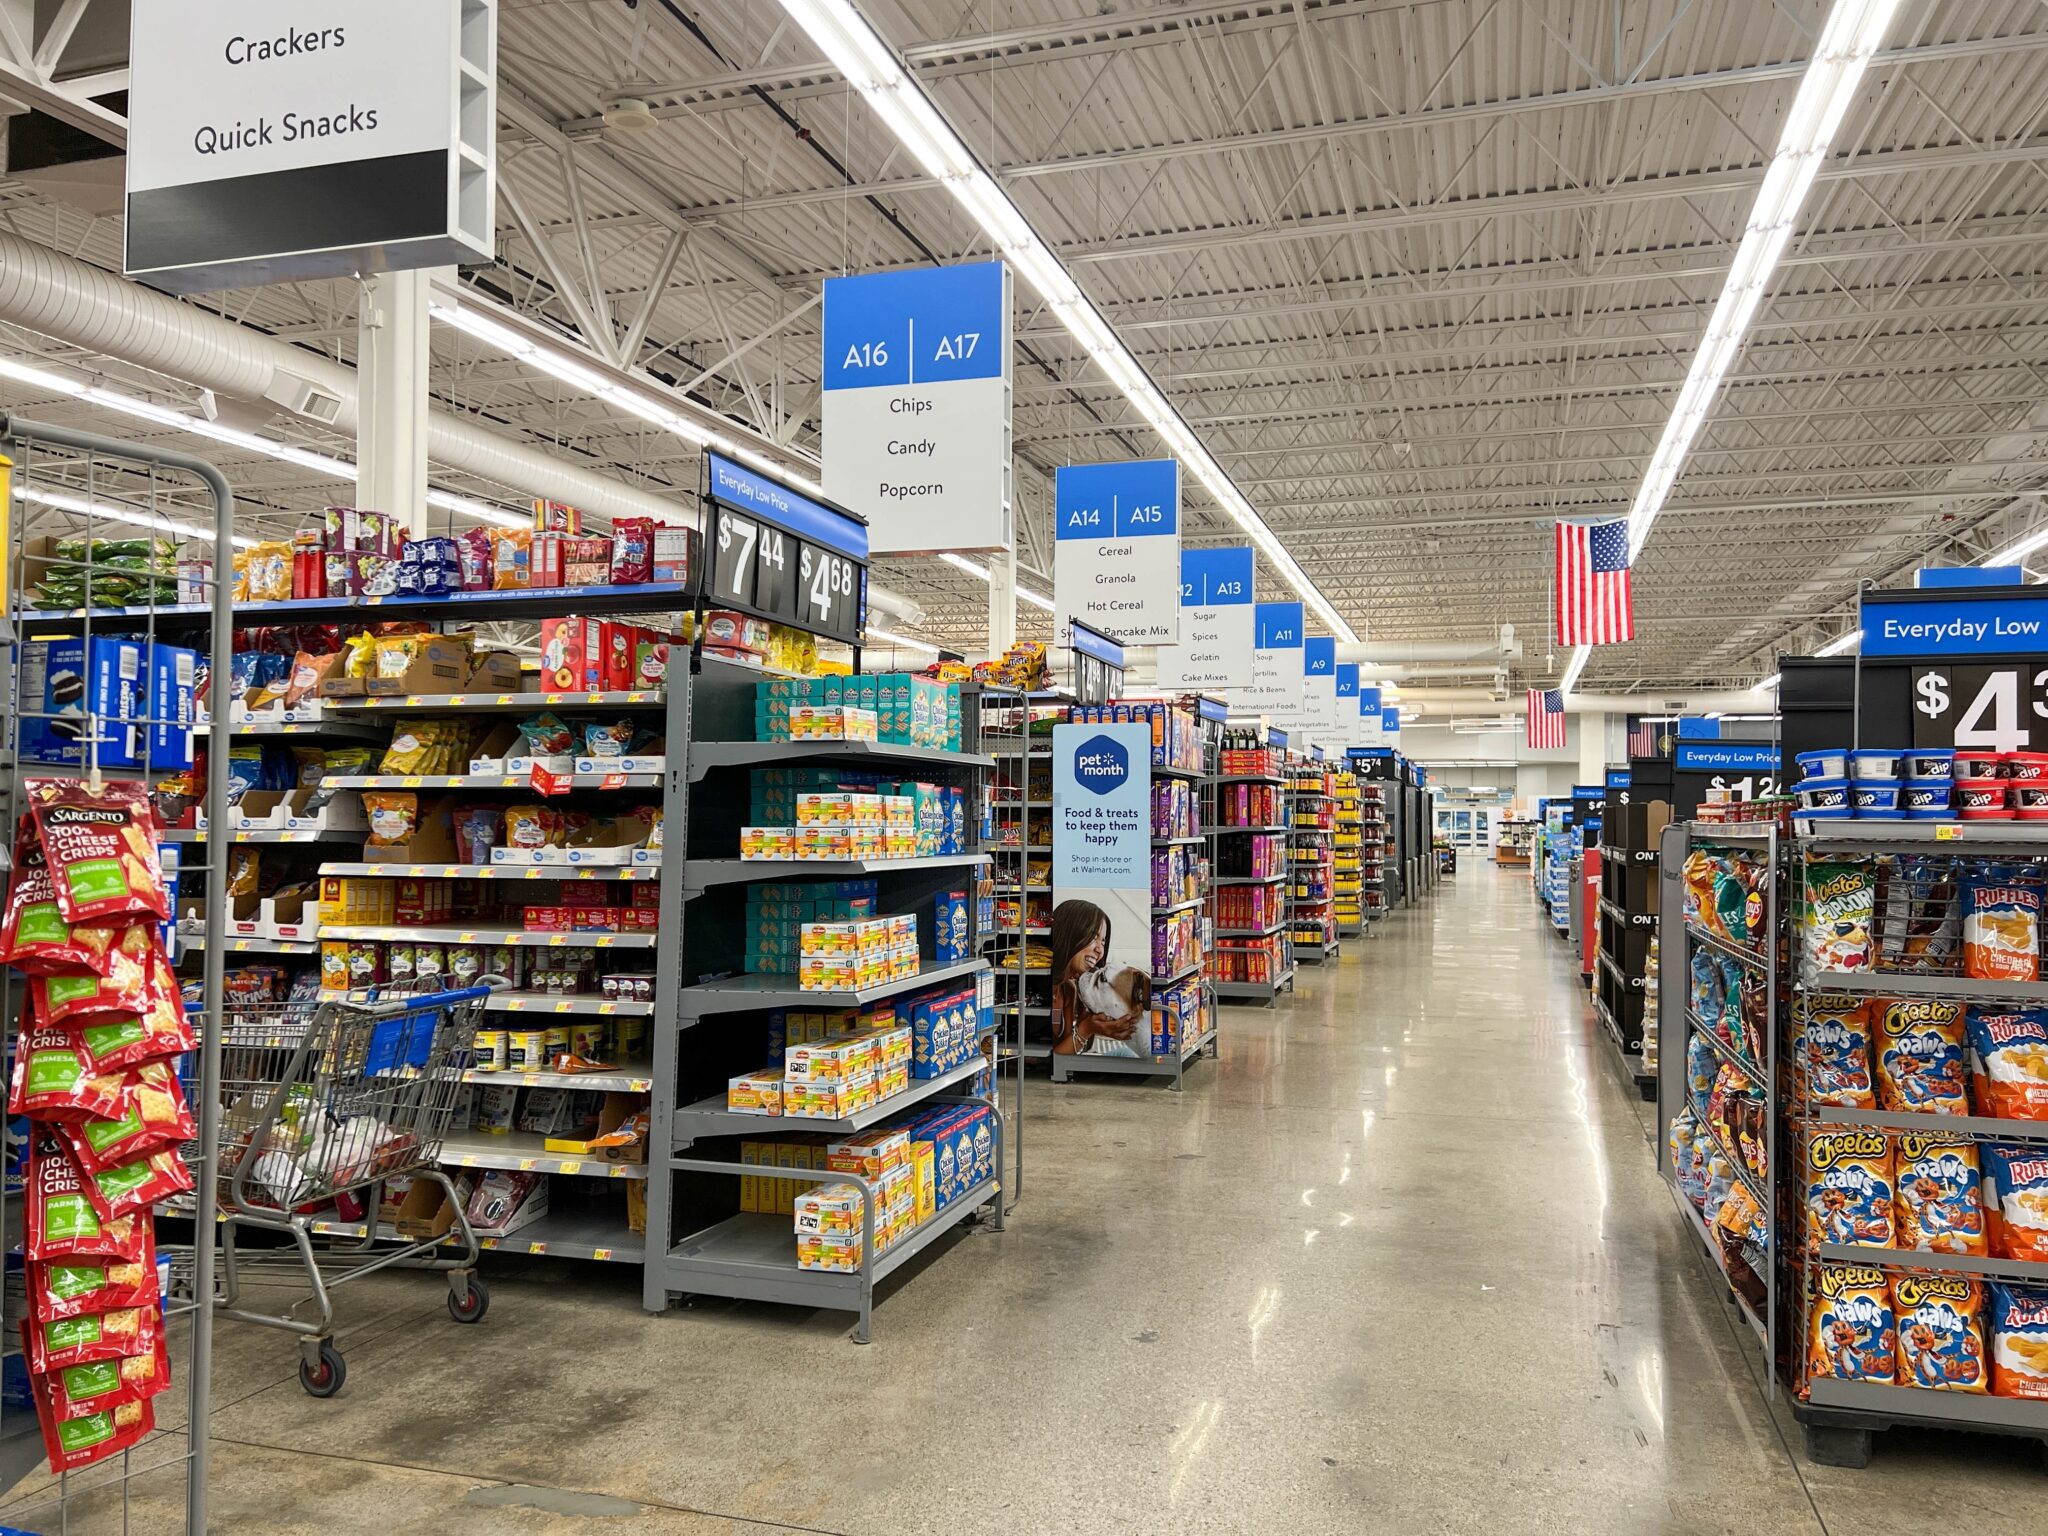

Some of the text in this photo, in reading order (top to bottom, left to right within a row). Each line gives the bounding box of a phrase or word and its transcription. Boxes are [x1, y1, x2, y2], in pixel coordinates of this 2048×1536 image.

[225, 27, 346, 65] Crackers
[194, 104, 378, 154] Quick Snacks
[934, 333, 980, 361] A17
[843, 341, 889, 369] A16
[890, 399, 933, 416] Chips
[887, 440, 936, 457] Candy
[719, 469, 789, 512] Everyday Low Price
[880, 483, 943, 500] Popcorn
[1069, 509, 1101, 527] A14
[1130, 506, 1162, 524] A15
[1098, 546, 1132, 557] Cereal
[1095, 573, 1136, 584] Granola
[1181, 584, 1193, 596] 12
[1217, 582, 1241, 595] A13
[1087, 600, 1144, 611] Hot Cereal
[1193, 612, 1216, 621] Sugar
[1104, 626, 1169, 637] Pancake Mix
[1275, 630, 1292, 641] A11
[1884, 617, 2040, 642] Everyday Low
[1192, 632, 1218, 642] Spices
[1190, 653, 1220, 661] Gelatin
[1311, 660, 1326, 669] A9
[1182, 674, 1202, 682] Cake
[1339, 683, 1351, 692] A7
[1079, 754, 1101, 769] pet
[1686, 752, 1781, 763] Everyday Low Price
[1084, 764, 1124, 776] month
[1931, 760, 1950, 776] dip
[2019, 767, 2041, 779] dip
[1824, 792, 1843, 806] dip
[1857, 793, 1875, 806] dip
[1912, 792, 1933, 805] dip
[1971, 793, 1992, 806] dip
[50, 808, 124, 824] SARGENTO
[1065, 807, 1139, 818] Food & treats
[55, 826, 93, 838] 100%
[1065, 820, 1138, 834] to keep them
[58, 835, 120, 849] CHEESE
[1085, 833, 1119, 846] happy
[60, 847, 116, 861] CRISPS
[1071, 855, 1090, 864] Shop
[1092, 855, 1121, 863] in-store
[1635, 851, 1654, 861] ON
[1974, 887, 2040, 909] RUFFLES
[1632, 915, 1651, 924] ON
[1885, 1002, 1959, 1034] Cheetos
[1808, 1025, 1850, 1048] paws
[1902, 1037, 1947, 1057] paws
[1811, 1134, 1885, 1167] Cheetos
[1915, 1160, 1969, 1183] paws
[1824, 1170, 1876, 1195] paws
[1822, 1266, 1884, 1296] Cheetos
[1898, 1278, 1968, 1305] Cheetos
[1834, 1302, 1883, 1328] paws
[1915, 1308, 1963, 1332] paws
